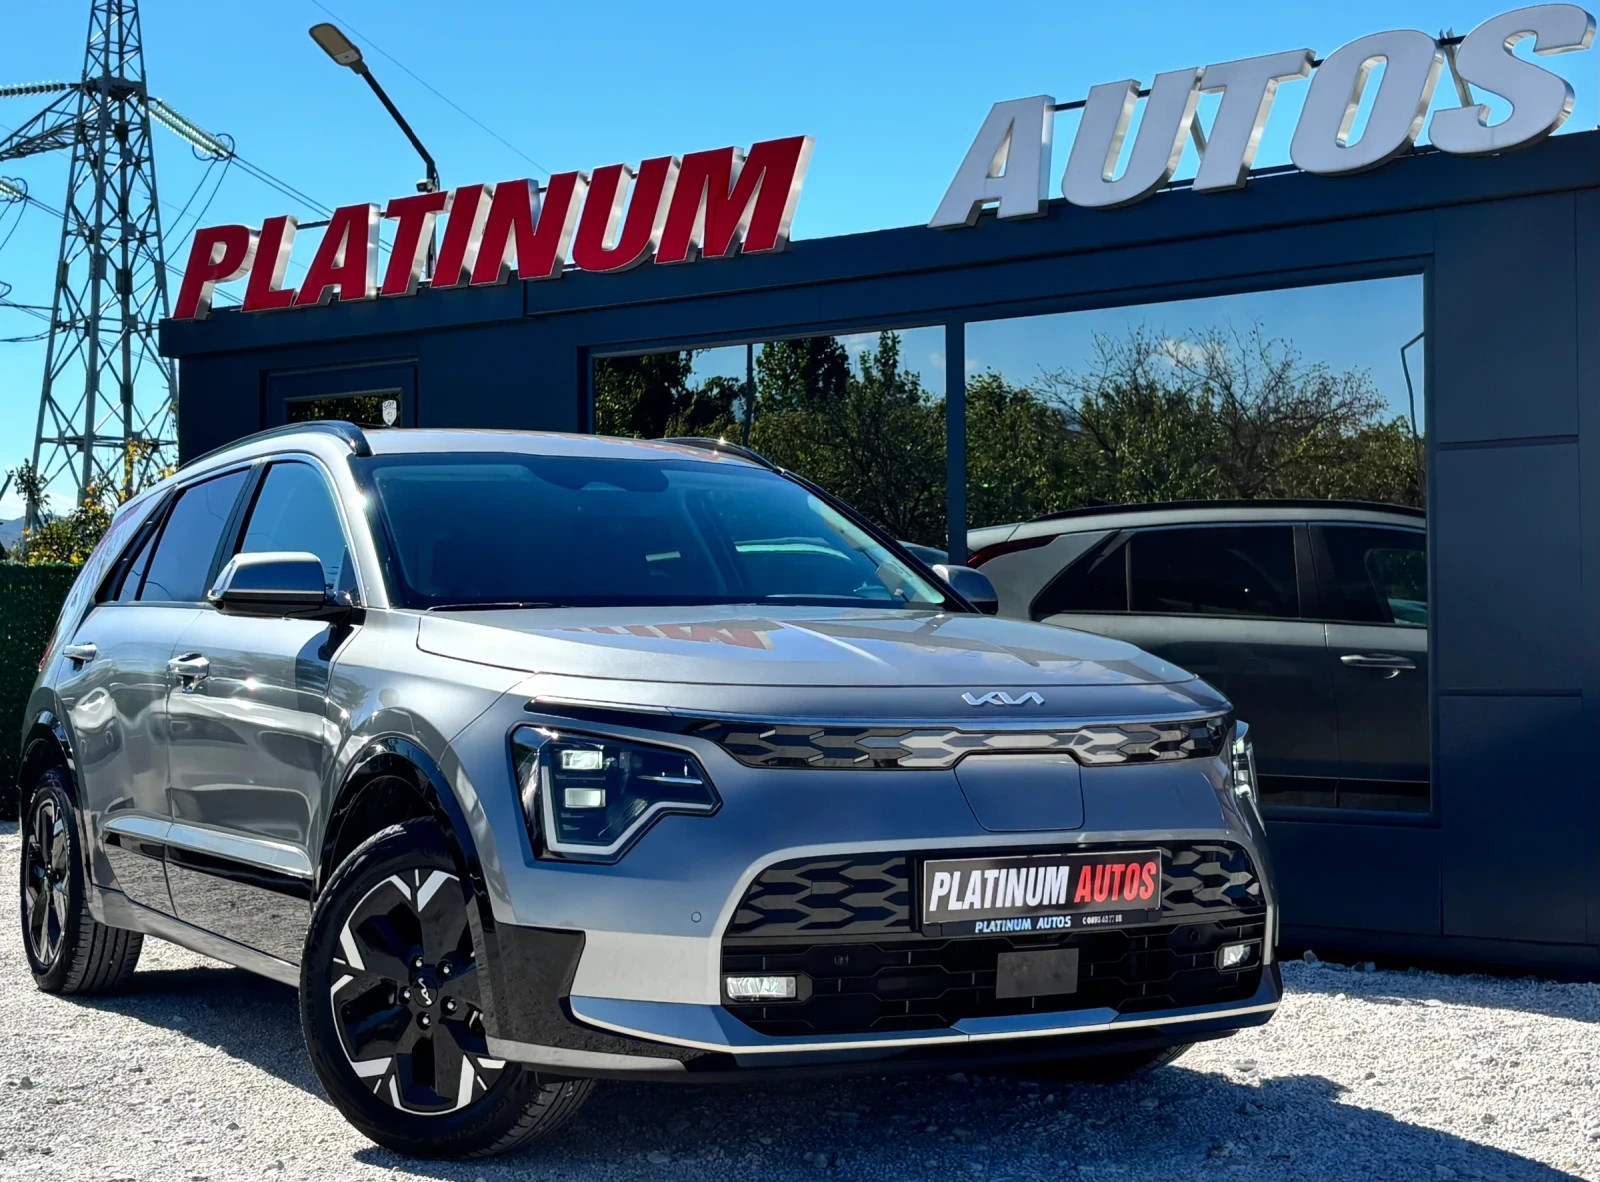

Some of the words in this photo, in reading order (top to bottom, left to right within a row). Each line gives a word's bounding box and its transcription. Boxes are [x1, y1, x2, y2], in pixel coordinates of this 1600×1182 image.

[172, 135, 814, 320] PLATINUM
[927, 3, 1597, 230] AUTOS
[962, 691, 1045, 706] KIA
[929, 865, 1070, 912] PLATINUM
[1074, 861, 1157, 904] AUTOS
[975, 917, 1032, 934] PLATINUM
[1036, 915, 1072, 929] AUTOS
